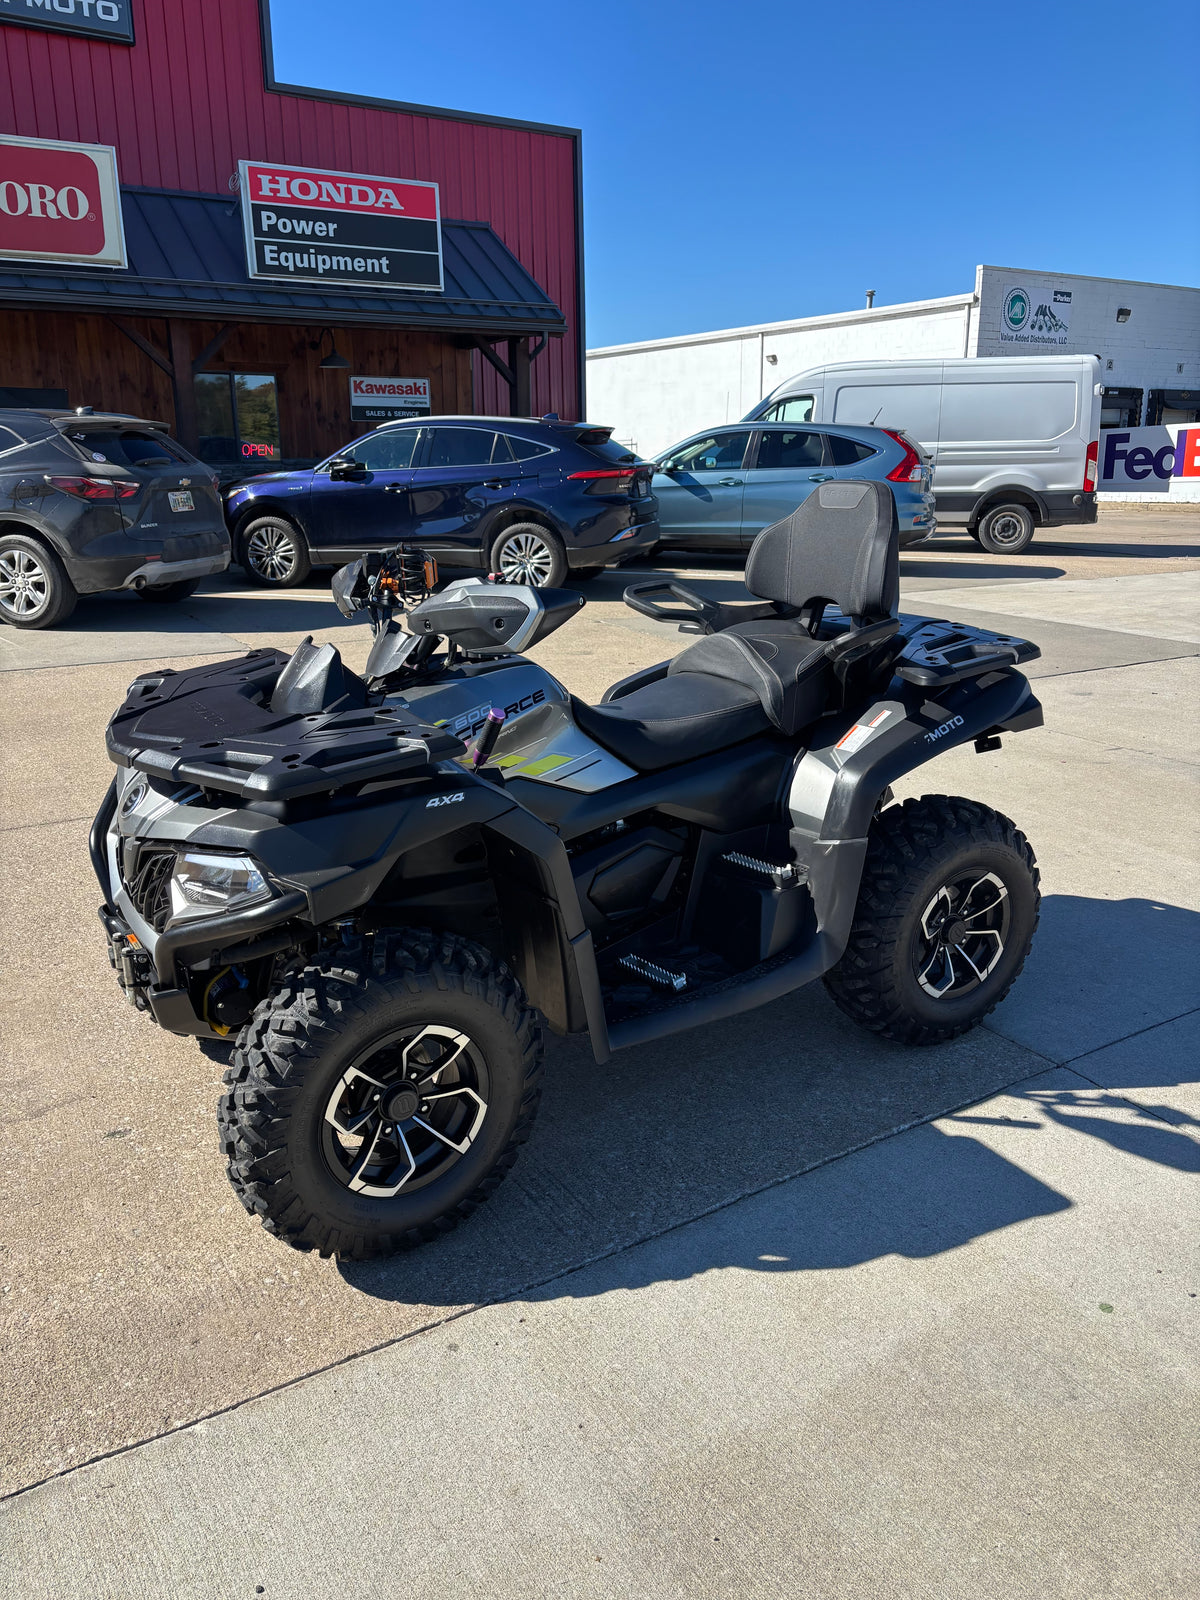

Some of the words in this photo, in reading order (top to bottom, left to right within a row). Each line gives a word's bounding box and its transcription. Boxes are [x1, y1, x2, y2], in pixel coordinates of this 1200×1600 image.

[0, 181, 89, 220] ORO
[257, 174, 404, 210] HONDA
[260, 210, 337, 237] Power
[264, 245, 390, 274] Equipment
[1001, 333, 1014, 342] Value
[1015, 334, 1030, 343] Added
[1059, 337, 1068, 345] LLC
[353, 380, 427, 396] Kawasaki
[393, 410, 420, 418] SERVICE
[241, 444, 274, 456] OPEN
[454, 689, 546, 742] CFRCE
